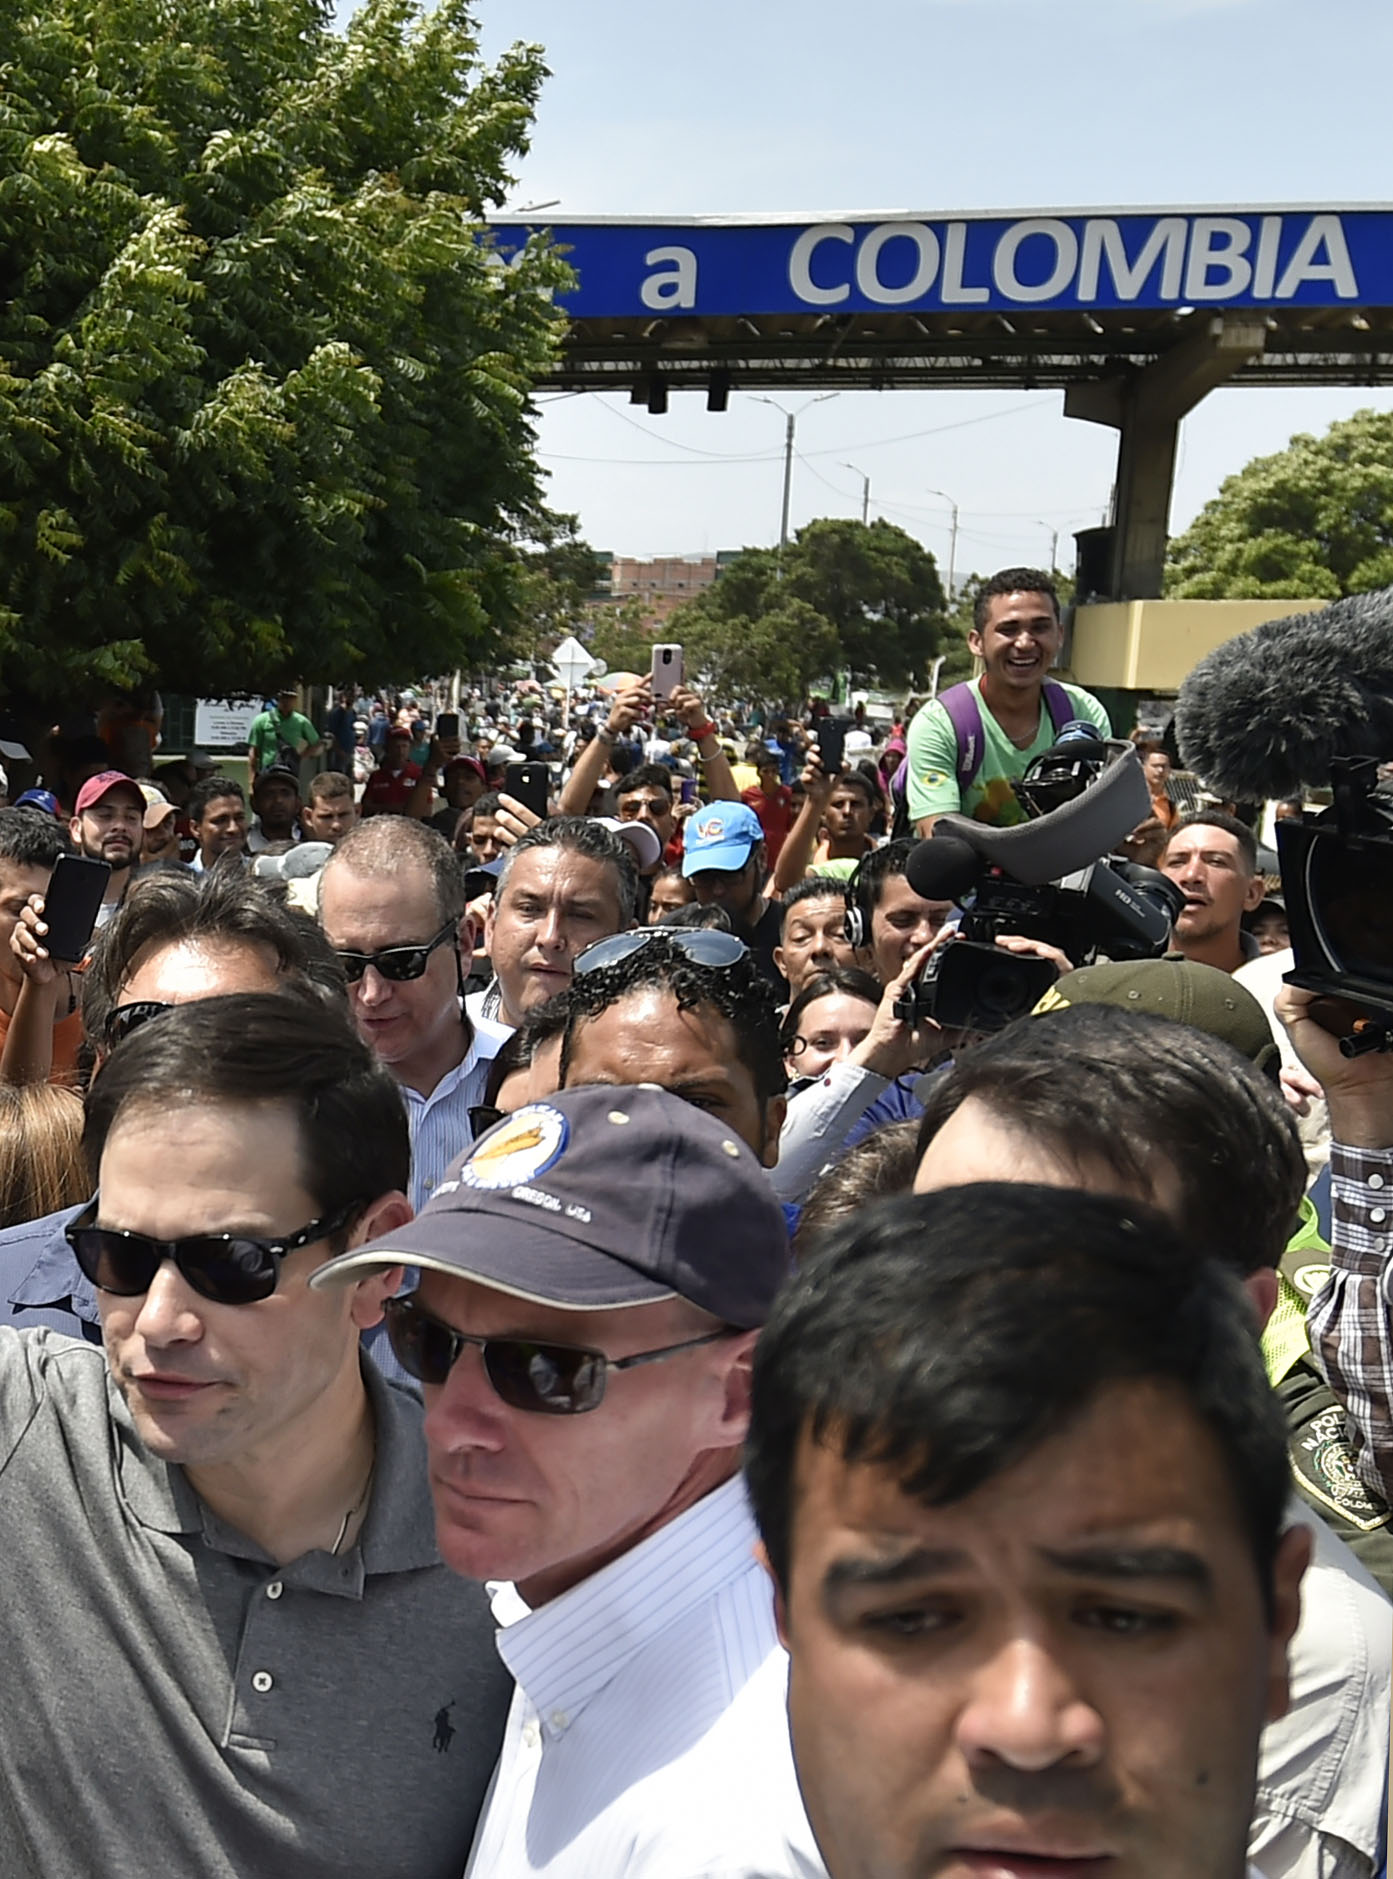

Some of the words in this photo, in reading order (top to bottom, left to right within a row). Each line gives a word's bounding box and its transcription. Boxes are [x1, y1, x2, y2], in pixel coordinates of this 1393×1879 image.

[641, 246, 697, 310] a
[788, 214, 1360, 305] COLOMBIA
[565, 1204, 591, 1223] USA
